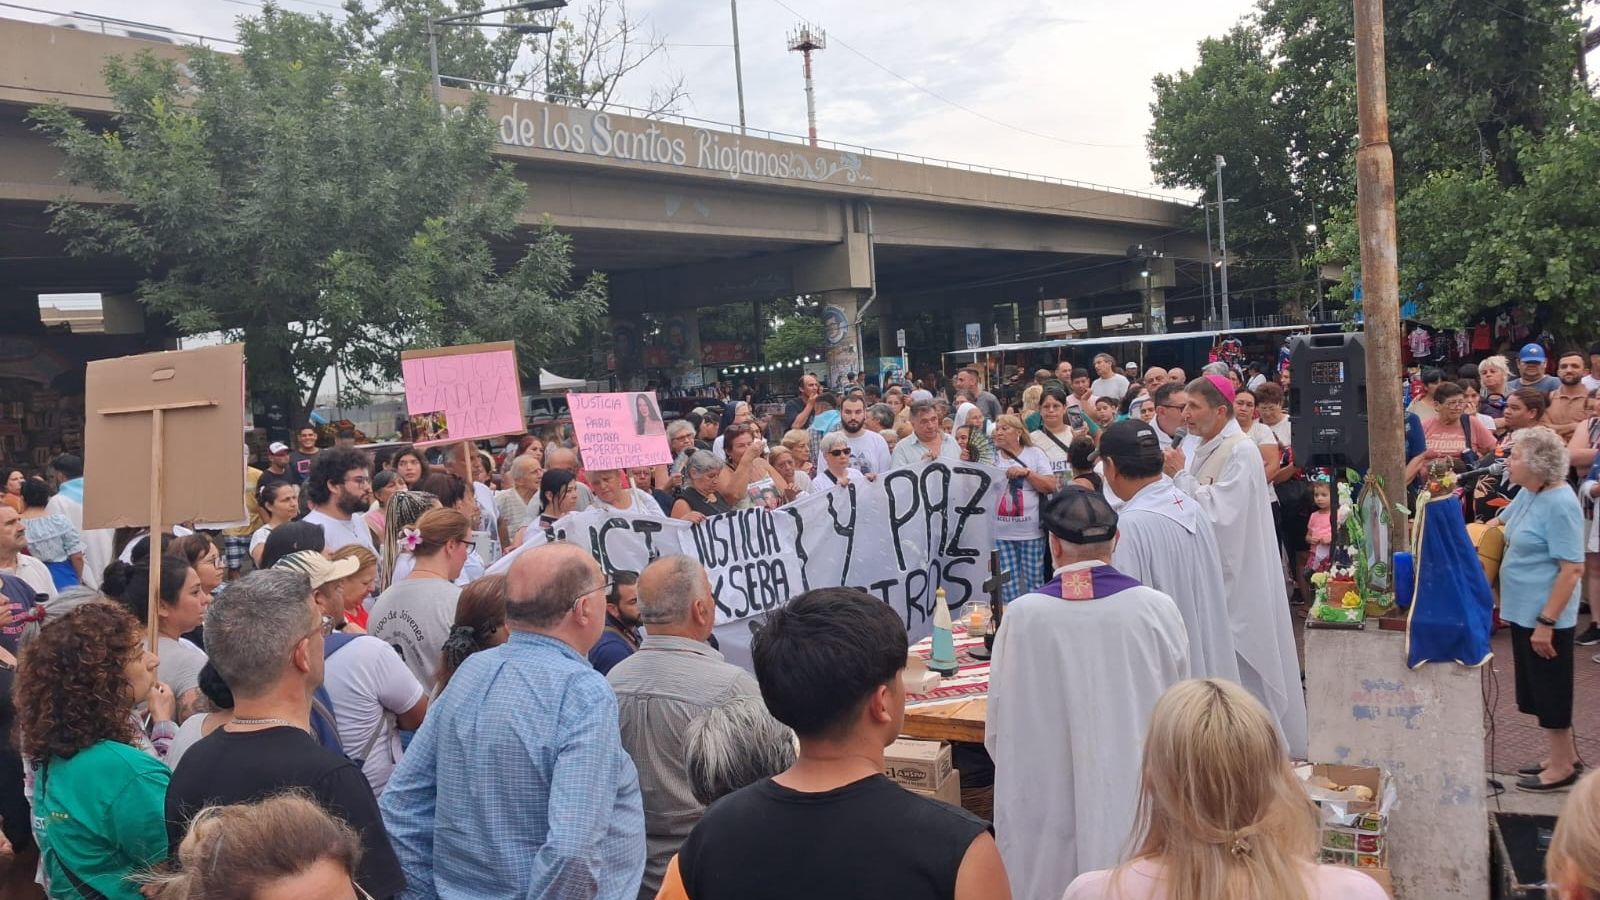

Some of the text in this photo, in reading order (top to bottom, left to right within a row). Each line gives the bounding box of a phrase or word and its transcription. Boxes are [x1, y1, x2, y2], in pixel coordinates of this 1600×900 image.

[501, 103, 534, 147] de
[543, 107, 585, 153] los
[591, 113, 687, 165] Santos
[696, 129, 790, 179] Riojanos
[575, 395, 622, 410] JUSTICIA
[585, 416, 611, 429] PARA
[690, 508, 780, 569] JUSTICIA
[826, 483, 856, 586] Y
[884, 463, 991, 571] PAZ
[388, 610, 397, 620] de
[730, 560, 789, 617] SEBA
[856, 557, 973, 631] TROS
